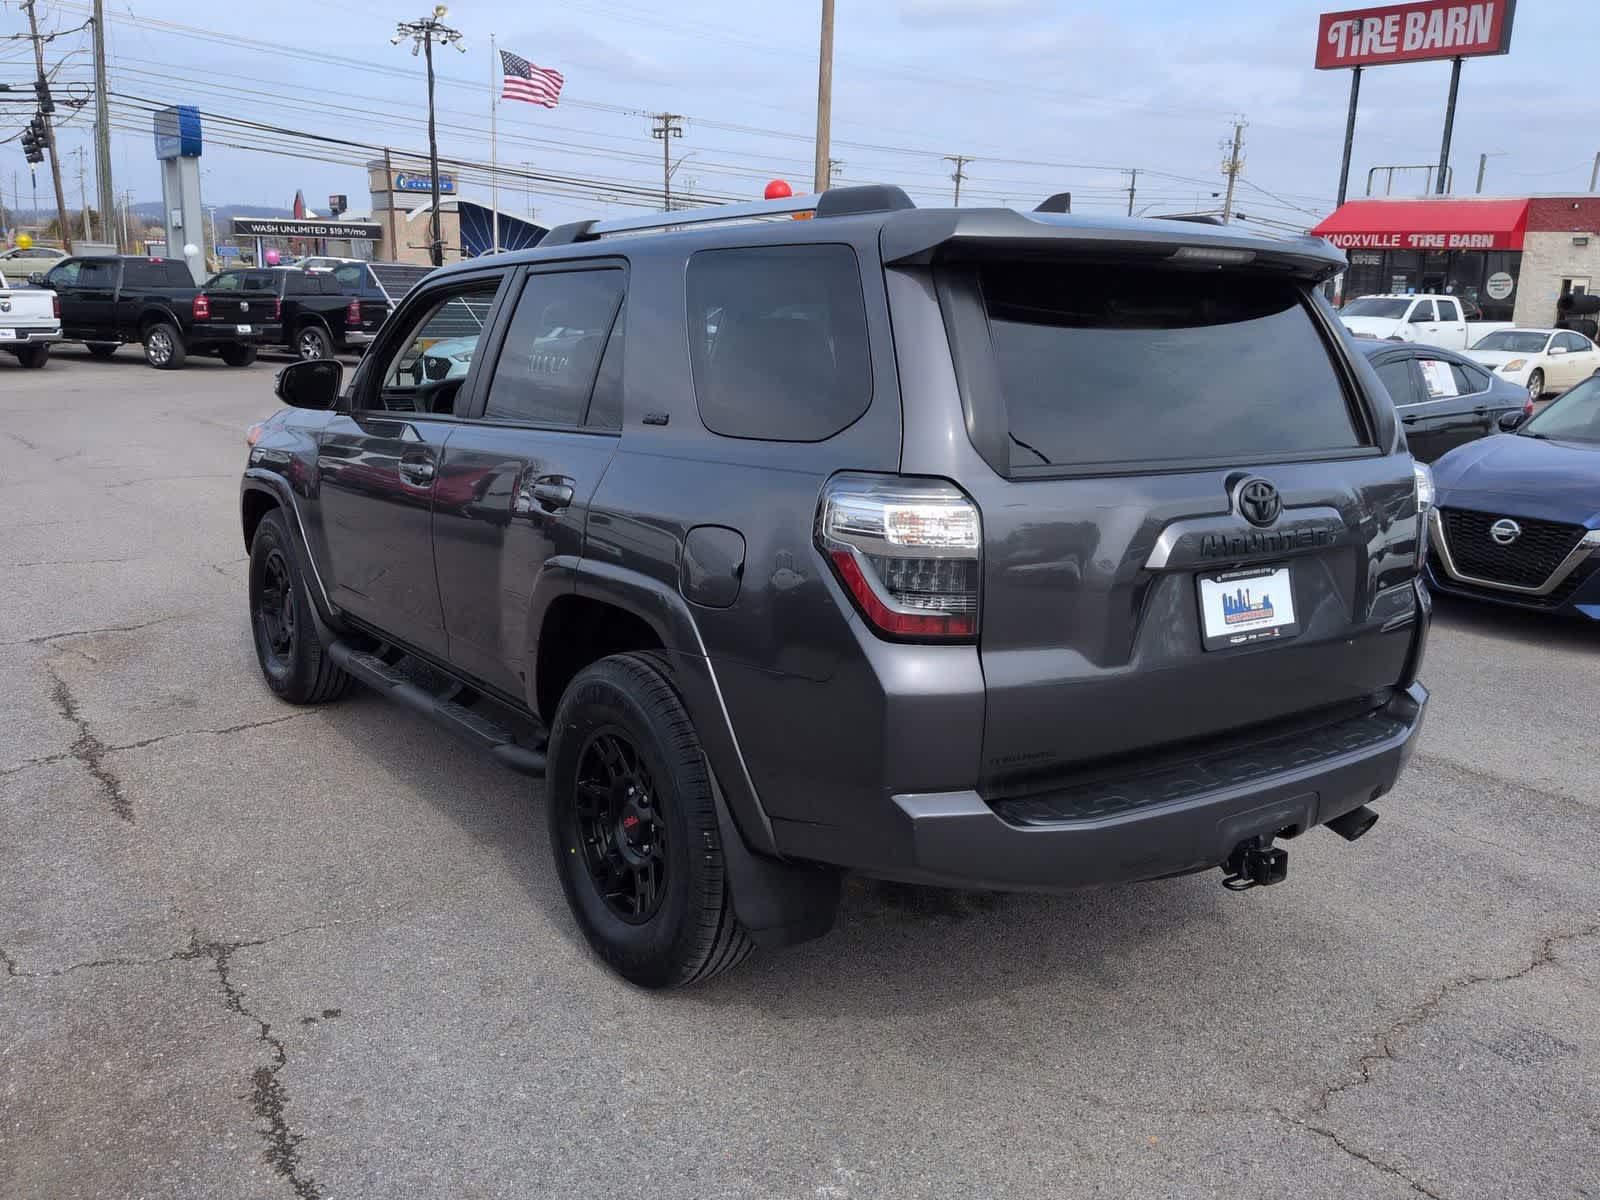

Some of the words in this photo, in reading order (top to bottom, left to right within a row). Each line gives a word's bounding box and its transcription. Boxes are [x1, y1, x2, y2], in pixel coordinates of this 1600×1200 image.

[1402, 2, 1494, 51] BARN
[251, 224, 278, 233] WASH
[279, 225, 327, 235] UNLIMITED
[1448, 234, 1494, 248] BARN
